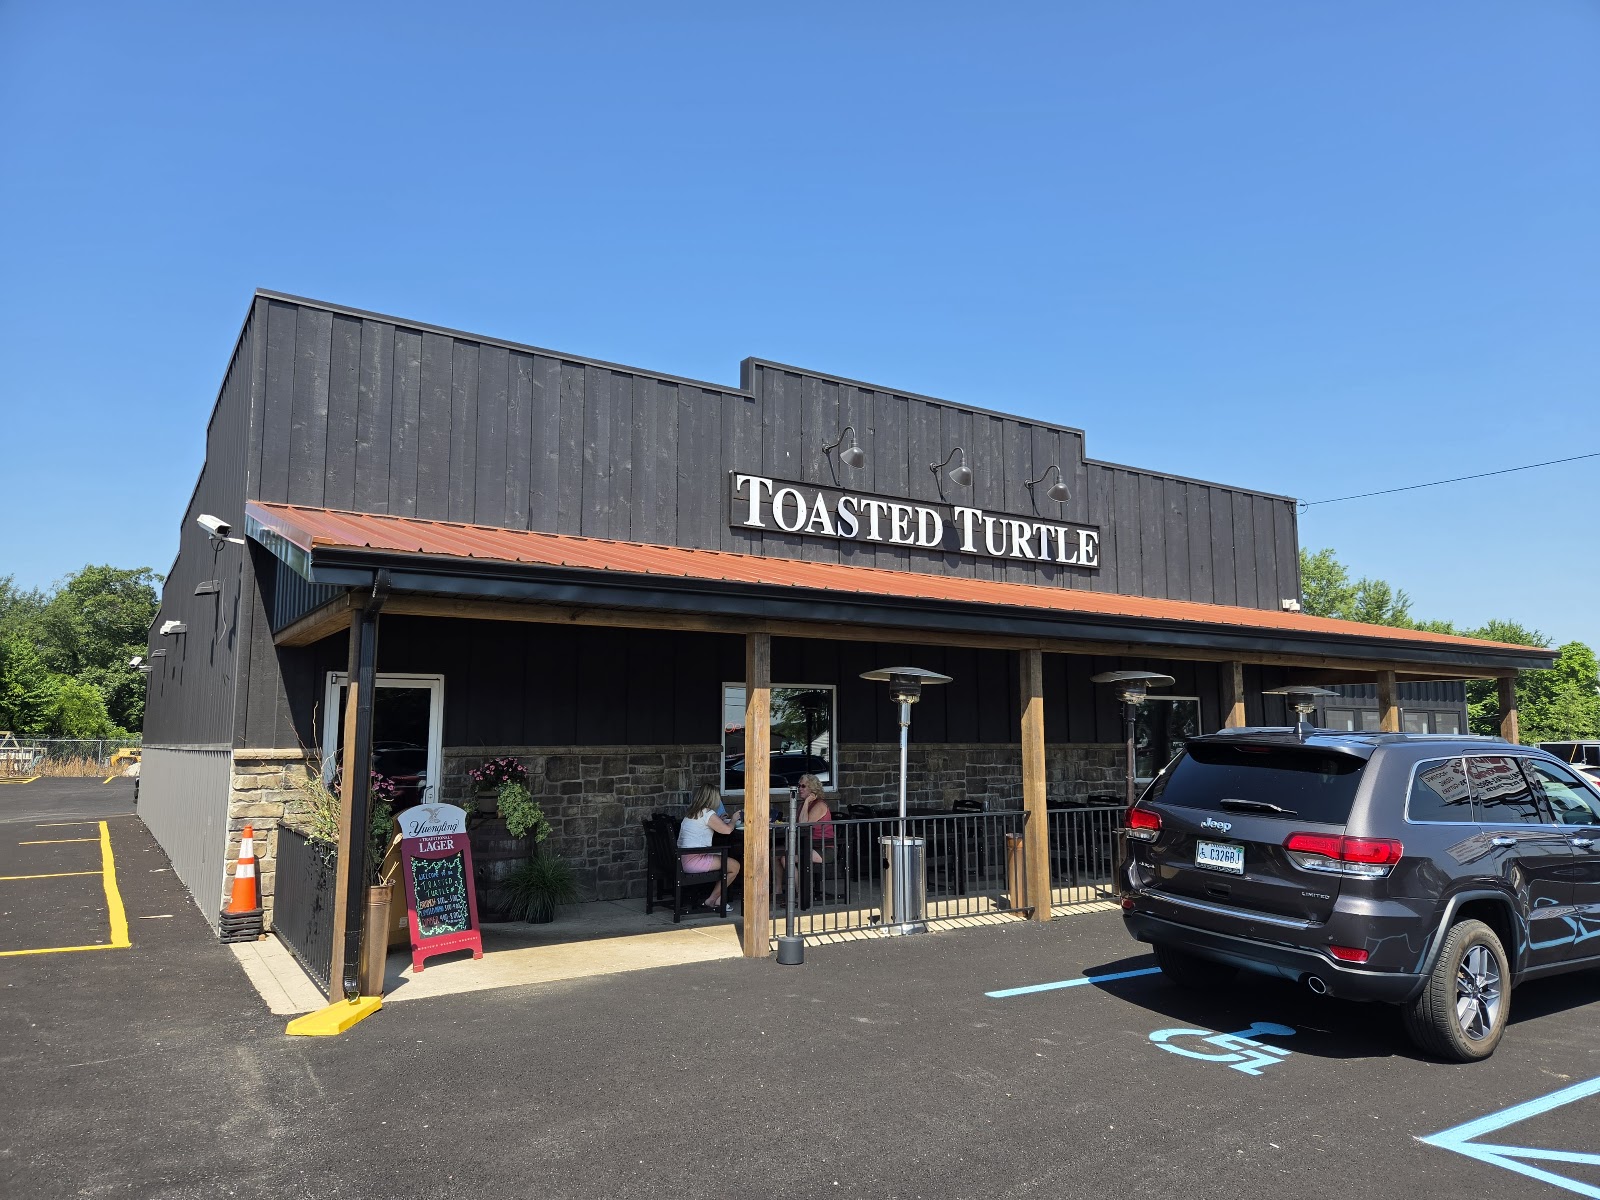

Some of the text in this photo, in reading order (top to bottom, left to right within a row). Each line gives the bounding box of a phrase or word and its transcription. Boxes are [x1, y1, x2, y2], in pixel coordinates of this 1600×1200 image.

[736, 474, 1099, 567] TOASTED TURTLE
[409, 818, 460, 838] Yuengling
[1200, 817, 1232, 833] Jeep
[419, 839, 455, 853] LAGER
[1210, 848, 1240, 865] C326BJ
[1301, 891, 1330, 900] LIMITED
